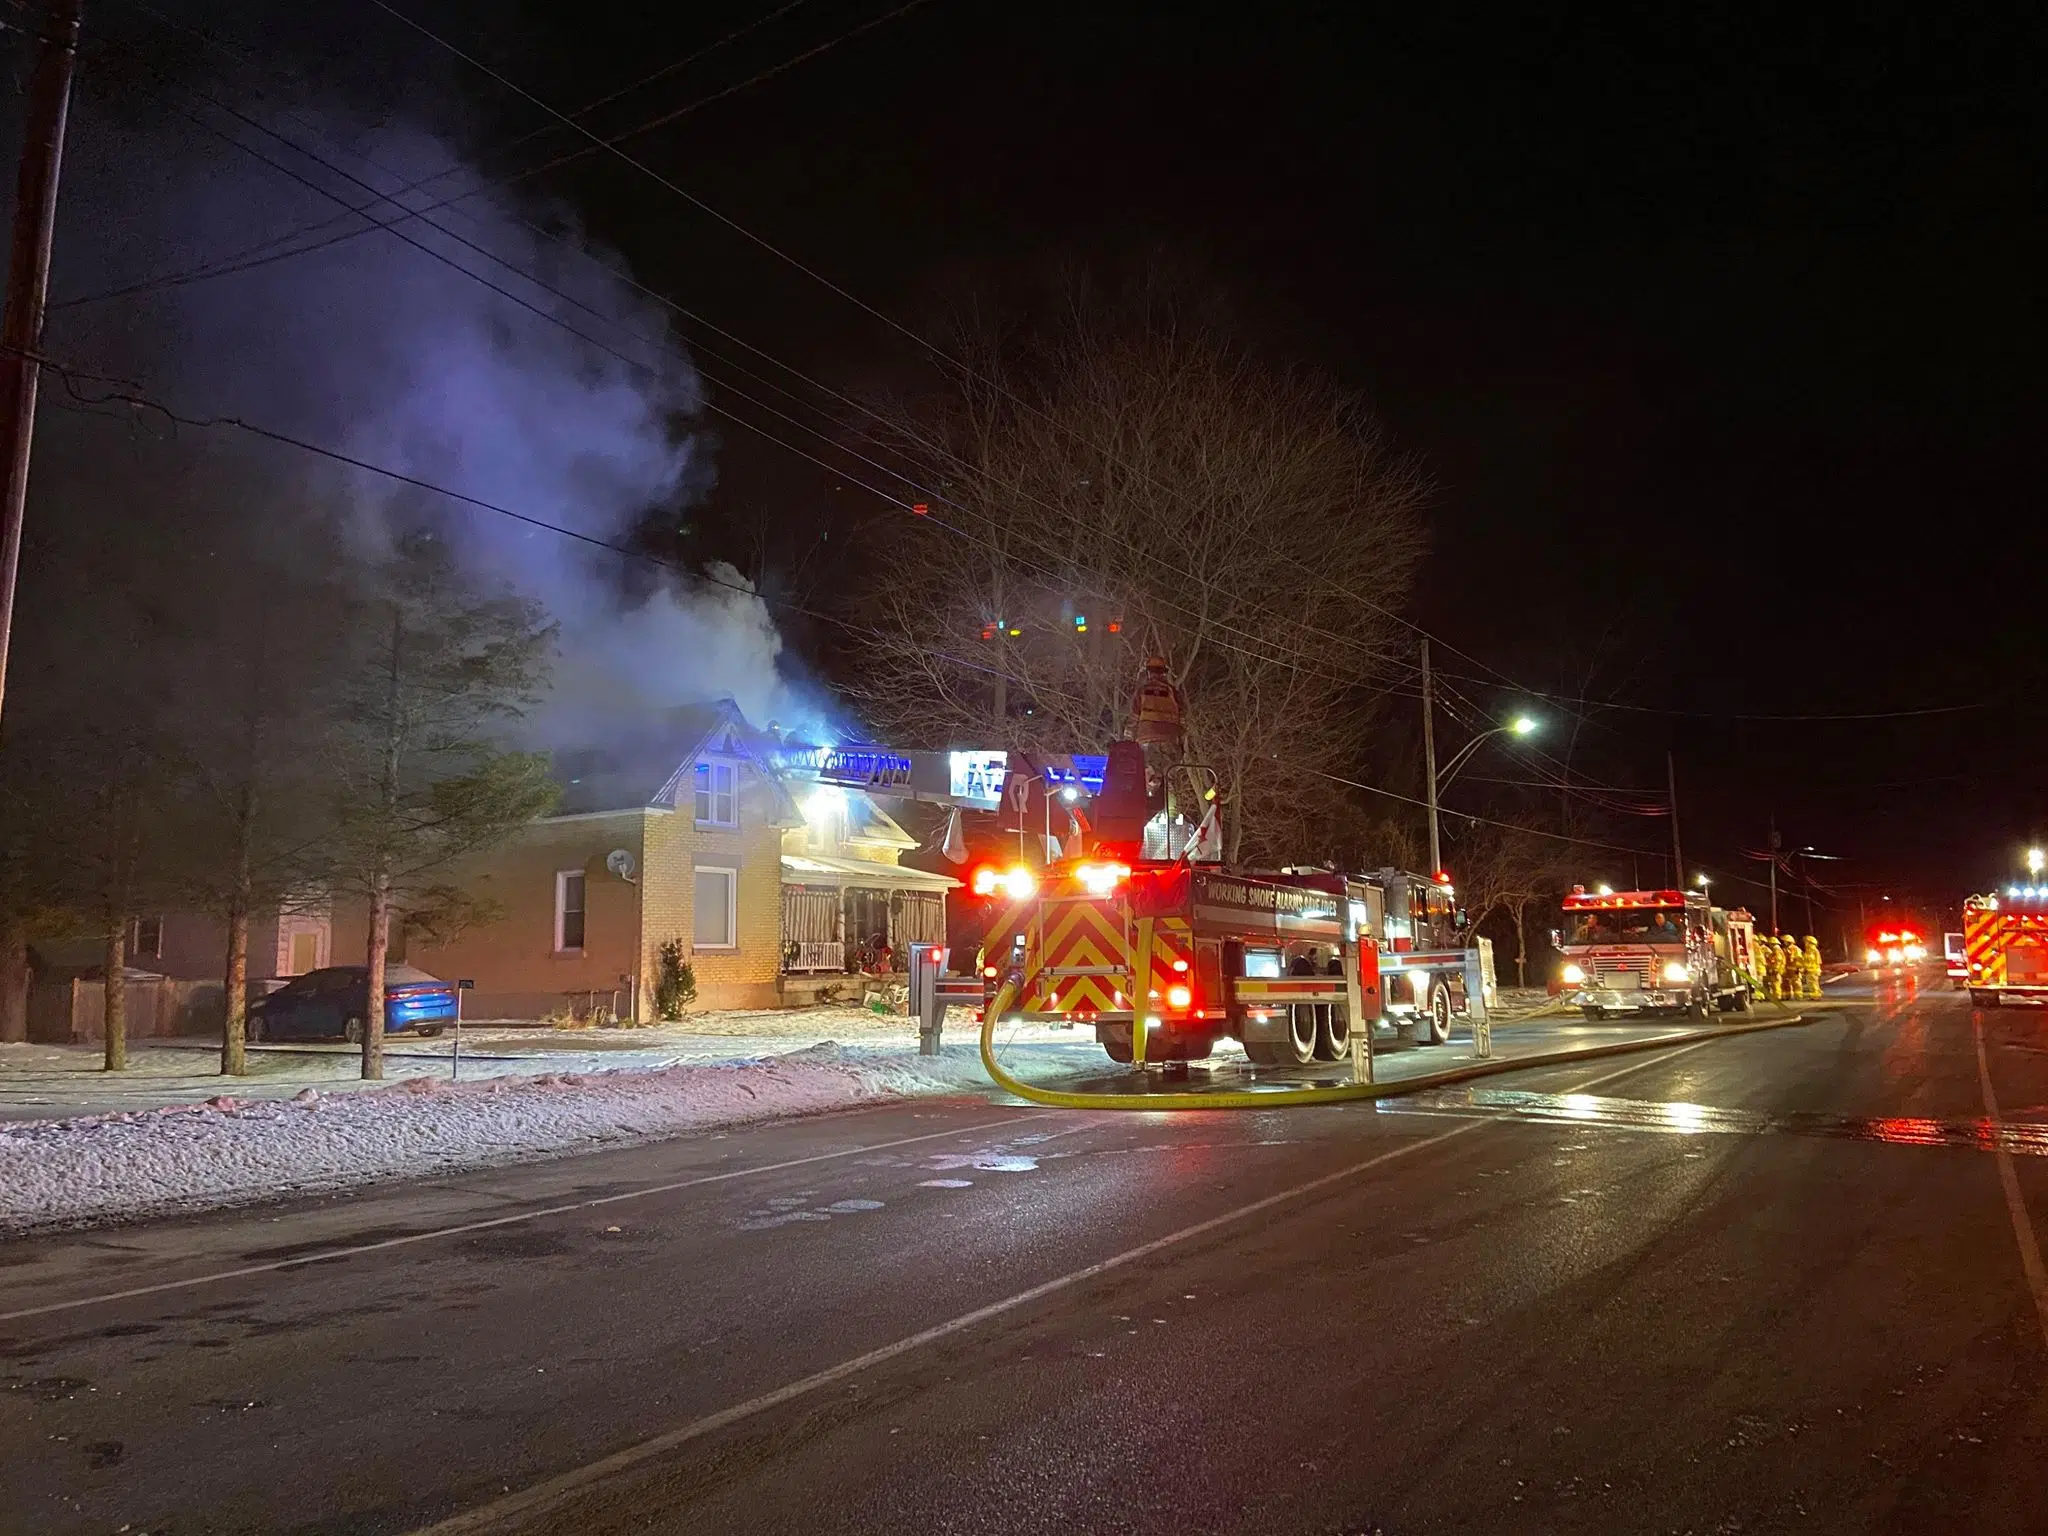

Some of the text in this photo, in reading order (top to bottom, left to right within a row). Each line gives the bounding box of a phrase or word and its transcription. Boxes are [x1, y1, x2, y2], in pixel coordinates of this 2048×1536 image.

[1209, 884, 1246, 904] WORKING
[1248, 887, 1275, 908] SMOKE
[1276, 892, 1304, 912] ALARMS
